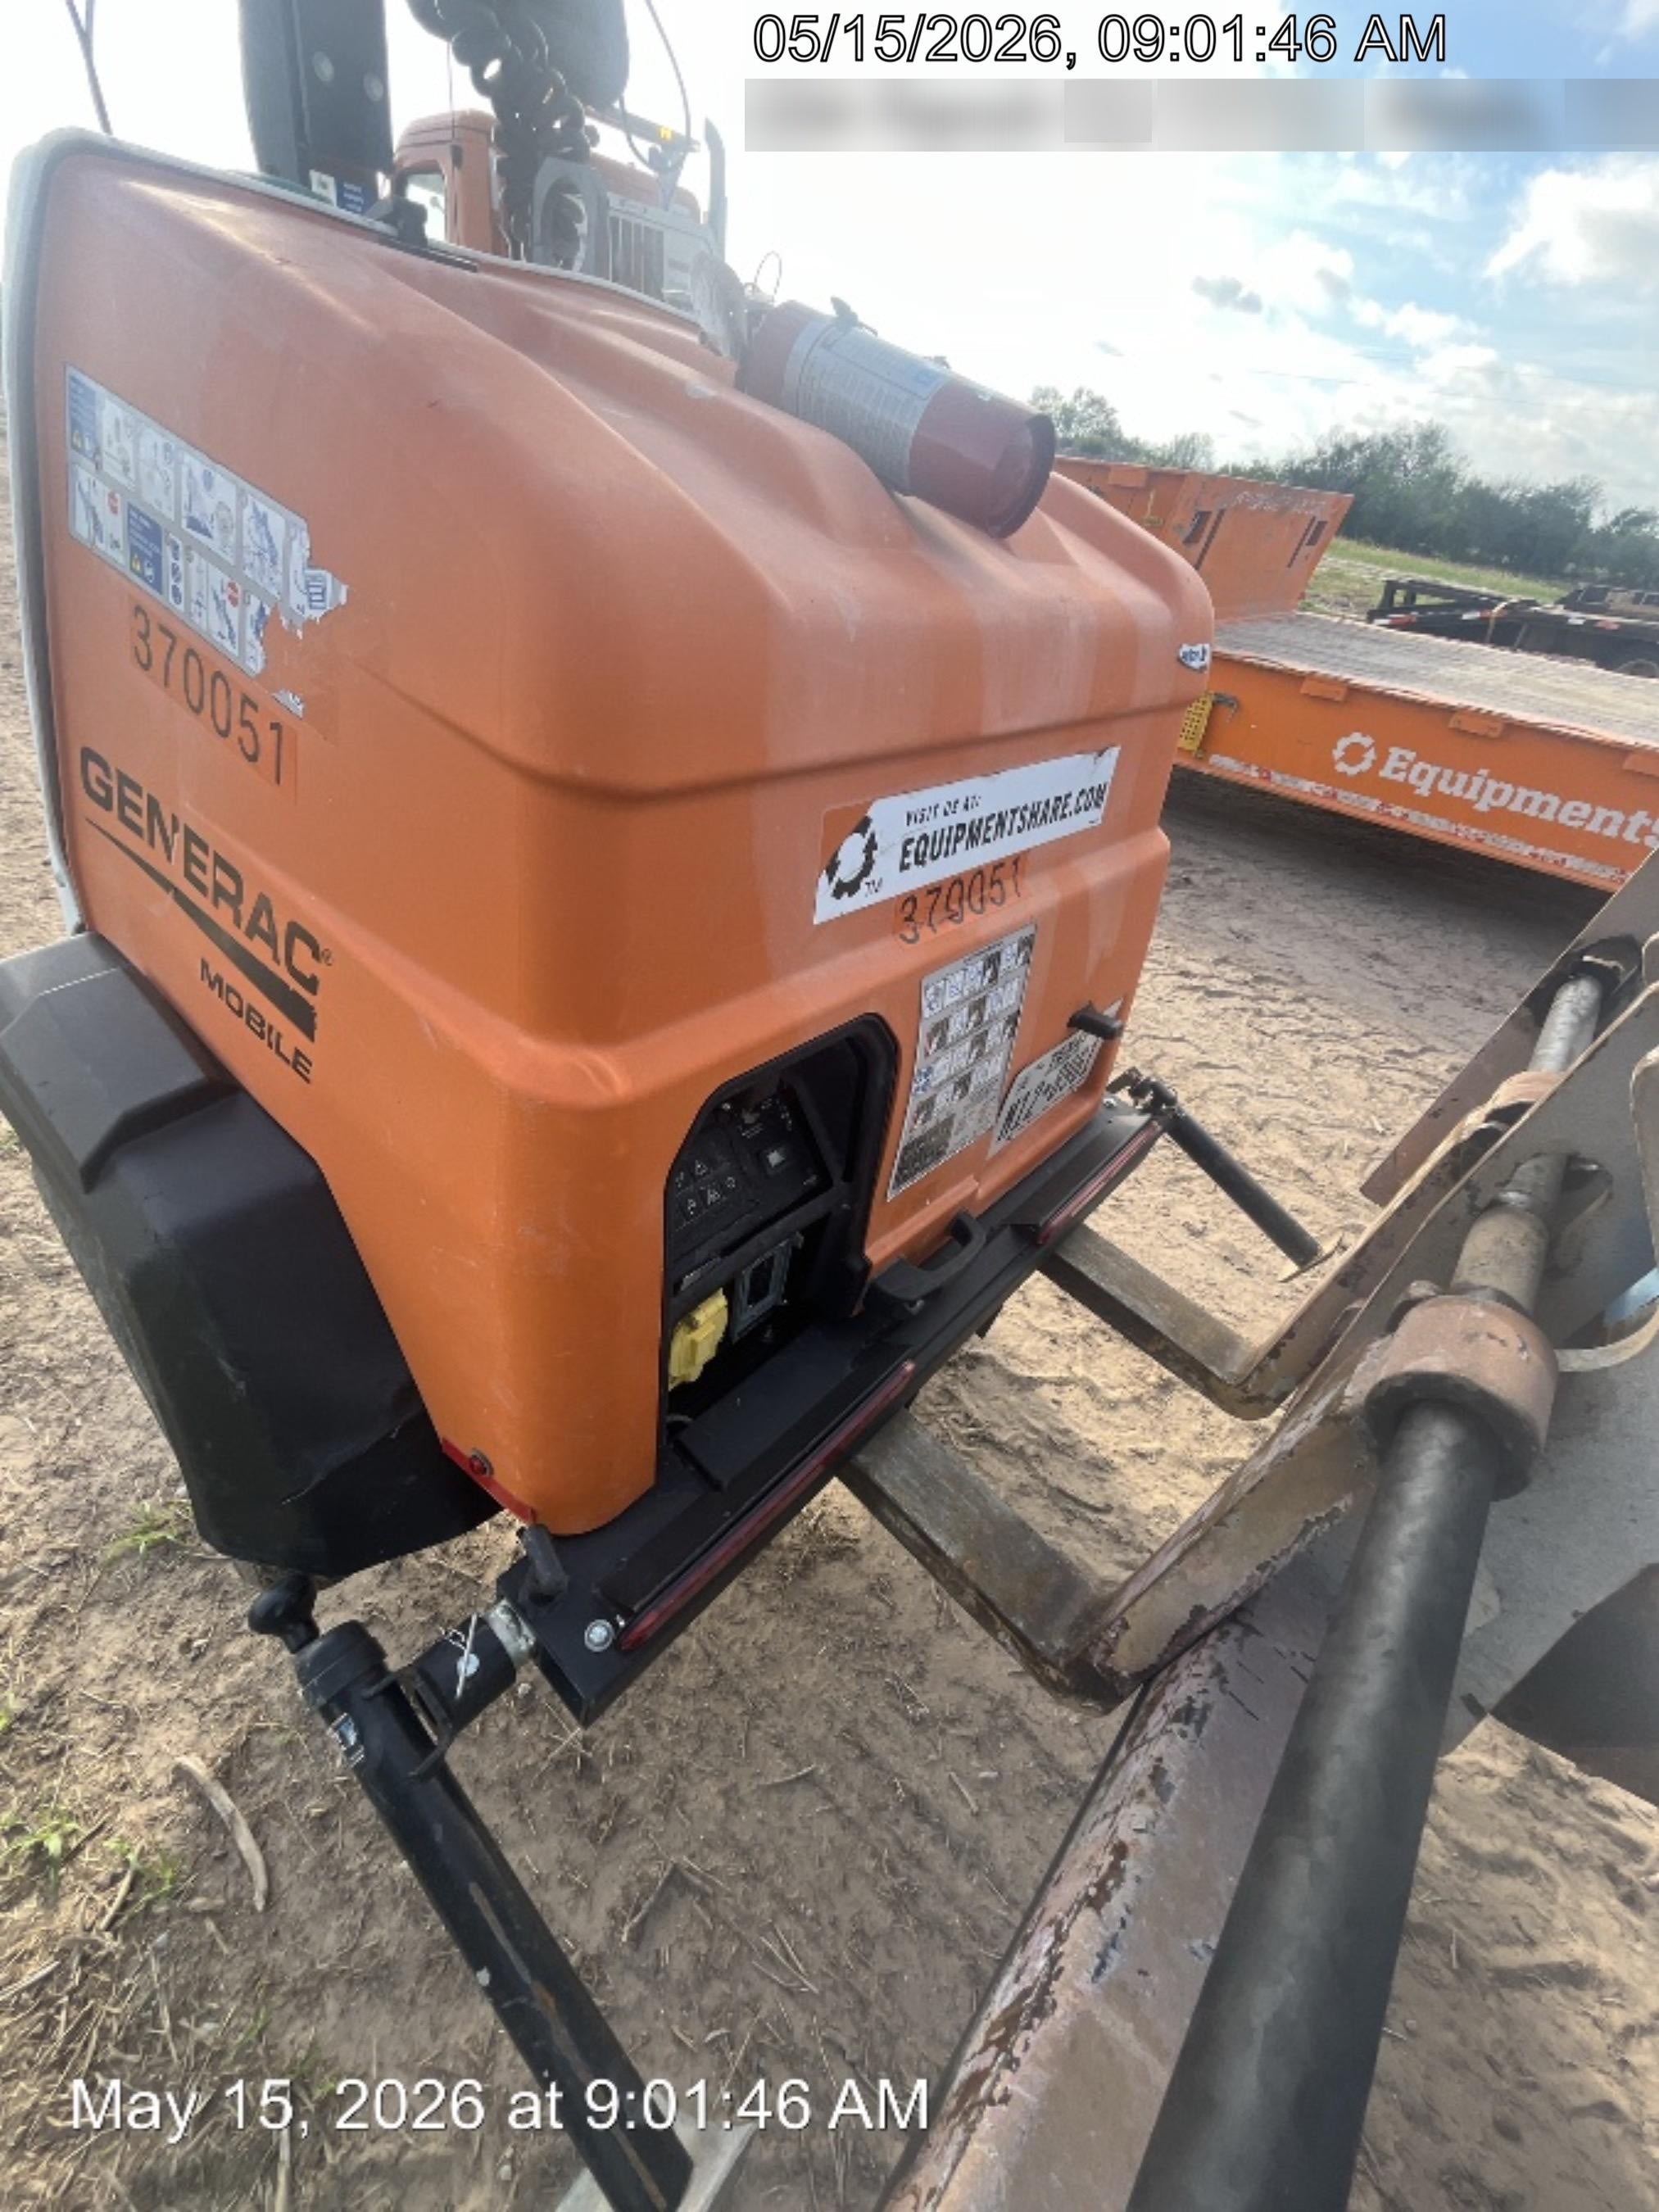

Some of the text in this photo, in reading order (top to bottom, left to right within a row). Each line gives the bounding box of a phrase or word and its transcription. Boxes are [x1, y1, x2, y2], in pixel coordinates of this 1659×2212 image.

[133, 605, 284, 786] 370051
[900, 782, 1108, 873] EQUIPMENTSHARE.COM
[199, 957, 313, 1085] MOBILE
